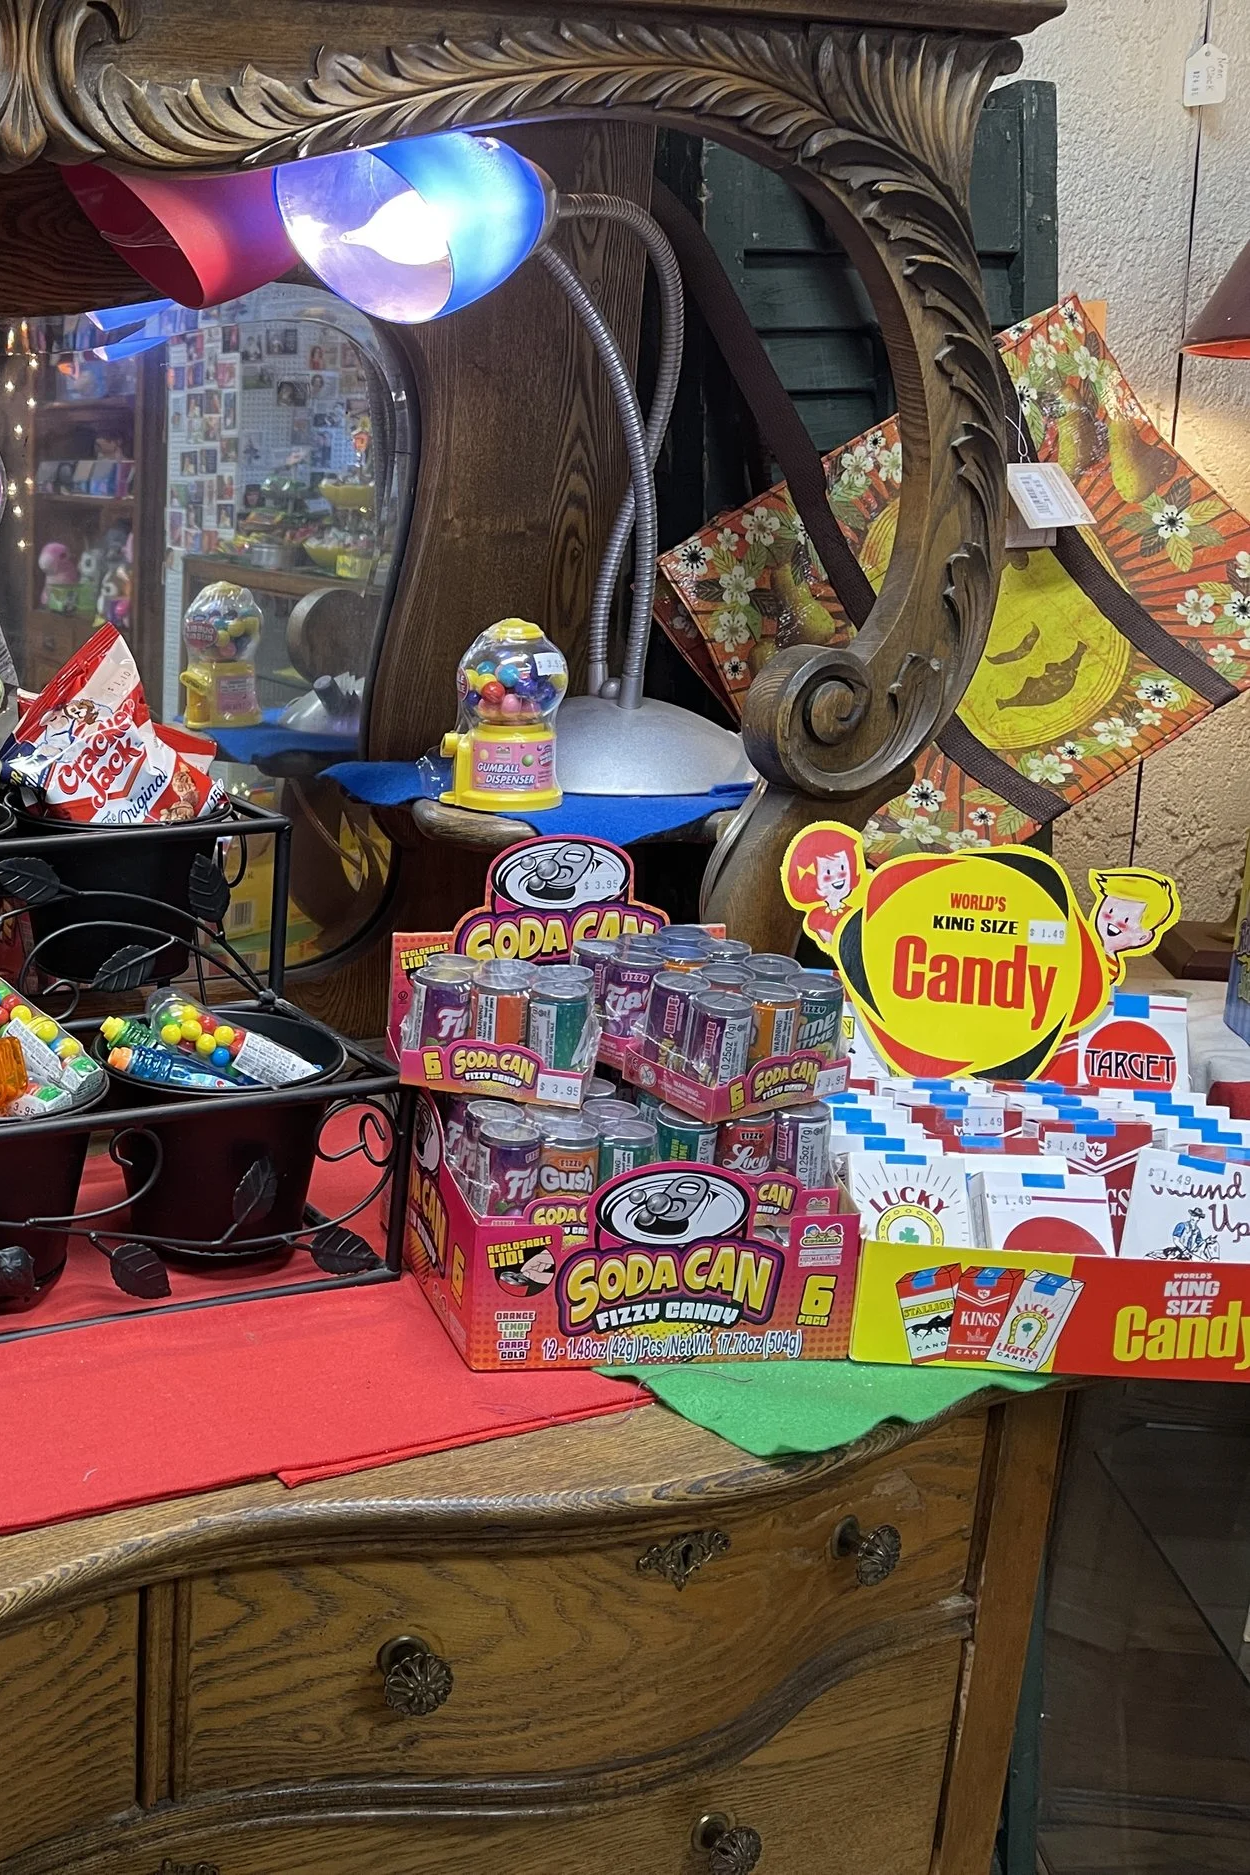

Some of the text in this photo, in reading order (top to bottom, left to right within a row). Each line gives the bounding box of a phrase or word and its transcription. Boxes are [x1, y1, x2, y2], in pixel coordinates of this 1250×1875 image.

[87, 738, 144, 810] Jack
[477, 762, 520, 773] GUMBALL
[485, 774, 535, 785] DISPENSER
[117, 766, 170, 824] Original
[595, 879, 618, 889] 3.95
[950, 892, 1007, 912] WORLD'S
[932, 915, 1018, 936] KING SIZE
[1039, 928, 1066, 940] 1.49
[466, 910, 655, 961] SODA CAN
[891, 935, 1058, 1031] Candy
[453, 1050, 537, 1084] SODA CAN
[1085, 1049, 1177, 1083] TARGET
[753, 1061, 820, 1097] SODA CAN
[551, 1084, 579, 1097] 3.95
[977, 1117, 1003, 1128] 1.49
[1058, 1140, 1085, 1152] 1.49
[540, 1165, 594, 1193] Gush
[1161, 1170, 1192, 1186] 1.49
[758, 1183, 792, 1210] CAN
[869, 1186, 950, 1216] LUCKY
[1004, 1195, 1032, 1206] 1.49
[533, 1206, 577, 1225] SODA
[1208, 1202, 1250, 1243] Up
[486, 1236, 552, 1255] RECLOSABLE
[488, 1249, 525, 1269] LID!
[1174, 1272, 1213, 1280] WORLD'S
[567, 1246, 774, 1325] SODA CAN
[1163, 1281, 1220, 1298] KING
[801, 1275, 837, 1316] 6
[496, 1311, 535, 1321] ORANGE
[595, 1302, 740, 1329] FIZZY CANDY
[903, 1300, 955, 1318] STALLION
[1016, 1303, 1056, 1321] LUCKY
[1166, 1300, 1214, 1316] SIZE
[499, 1322, 531, 1331] LEMON
[796, 1315, 828, 1326] PACK
[959, 1311, 1001, 1327] KINGS
[502, 1331, 526, 1339] LIME
[497, 1340, 530, 1349] GRAPE
[542, 1338, 557, 1361] 12
[568, 1337, 606, 1360] 1.48oz
[607, 1334, 639, 1364] (42g)
[716, 1330, 762, 1355] 17.78oz
[764, 1330, 803, 1360] (504g)
[916, 1341, 947, 1352] CAND
[996, 1342, 1039, 1359] LIGHTS
[501, 1350, 525, 1360] COLA
[996, 1351, 1034, 1364] CANDY
